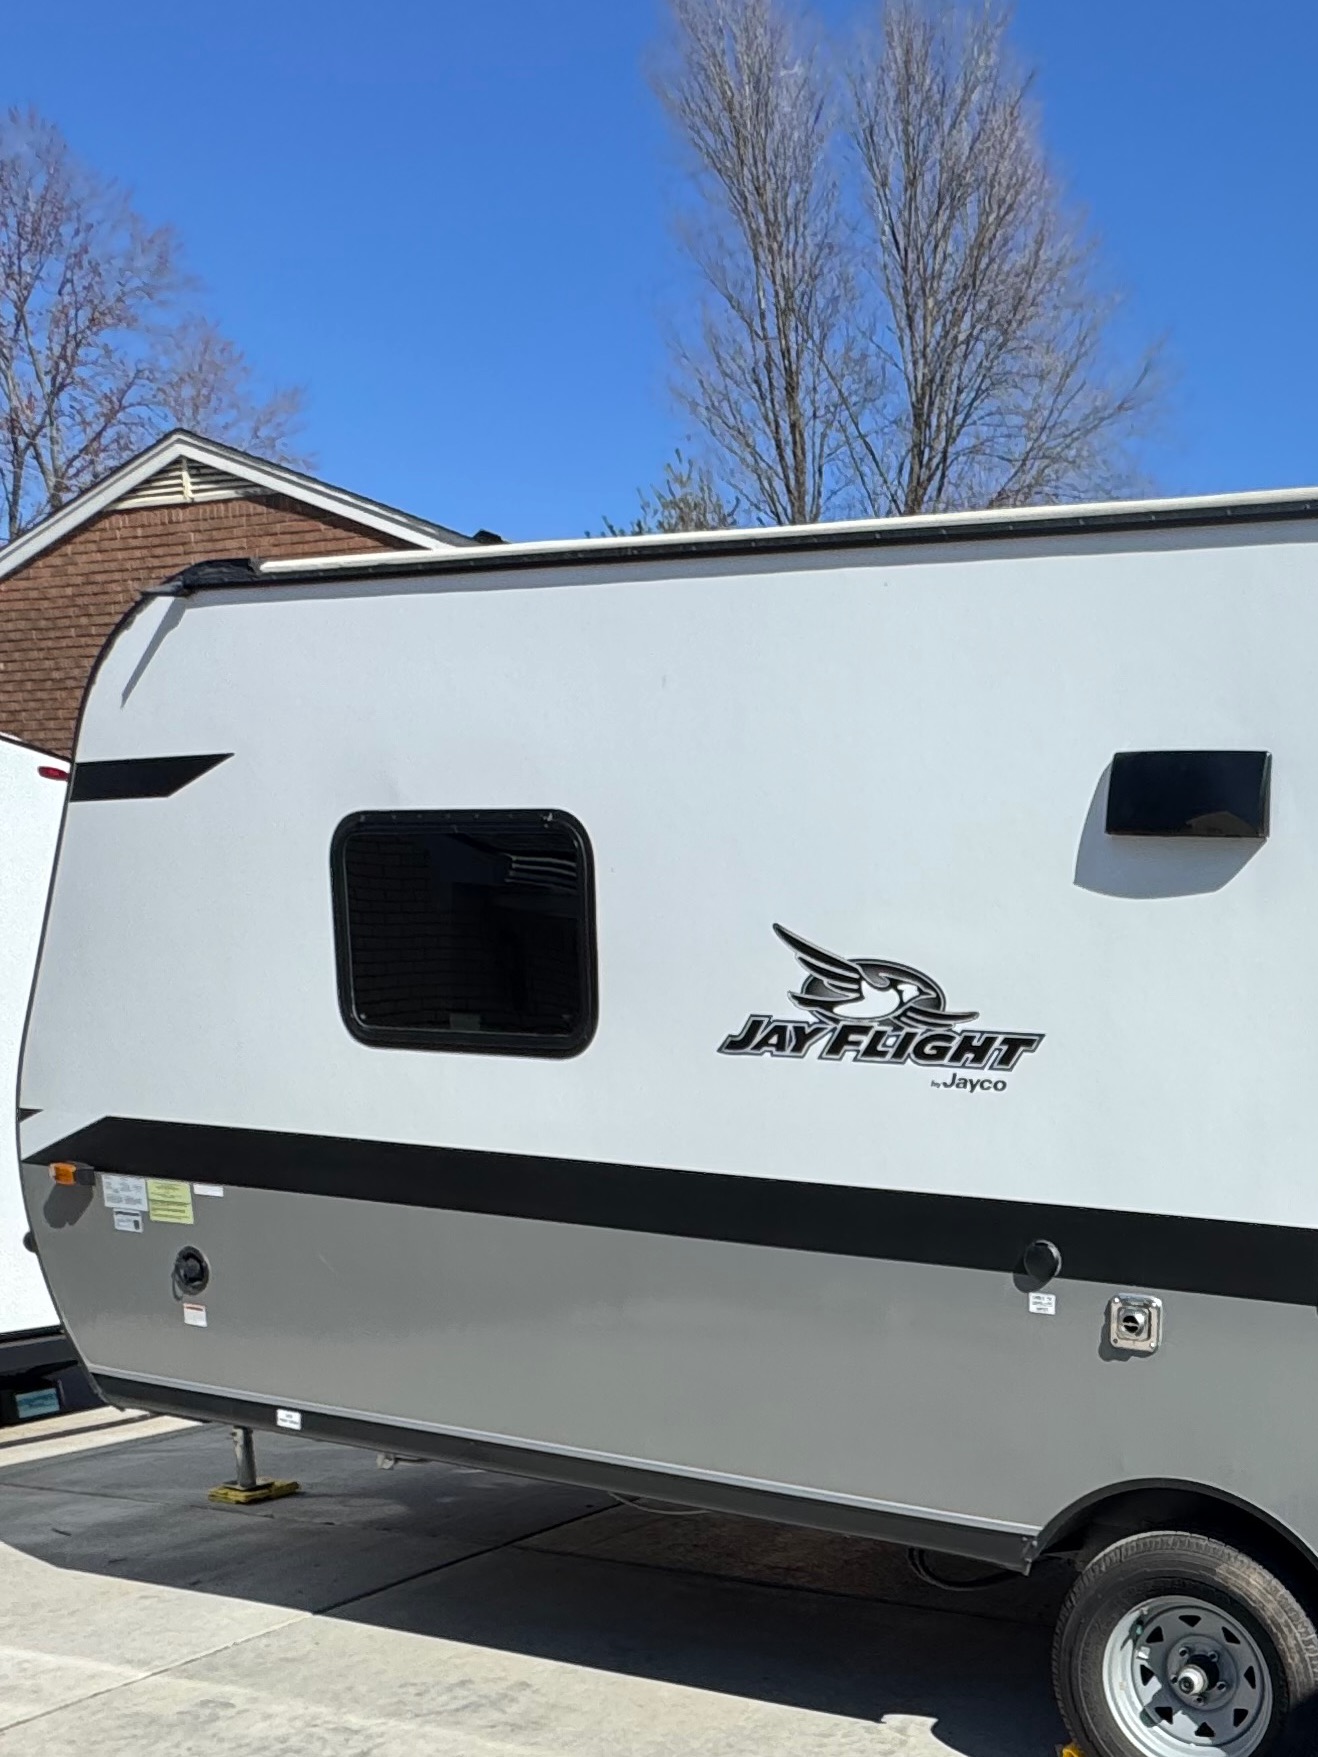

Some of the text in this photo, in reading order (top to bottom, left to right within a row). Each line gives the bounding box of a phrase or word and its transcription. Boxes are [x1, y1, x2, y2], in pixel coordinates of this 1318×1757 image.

[717, 1014, 1046, 1072] JAY FLIGHT
[942, 1072, 1007, 1093] Jayco
